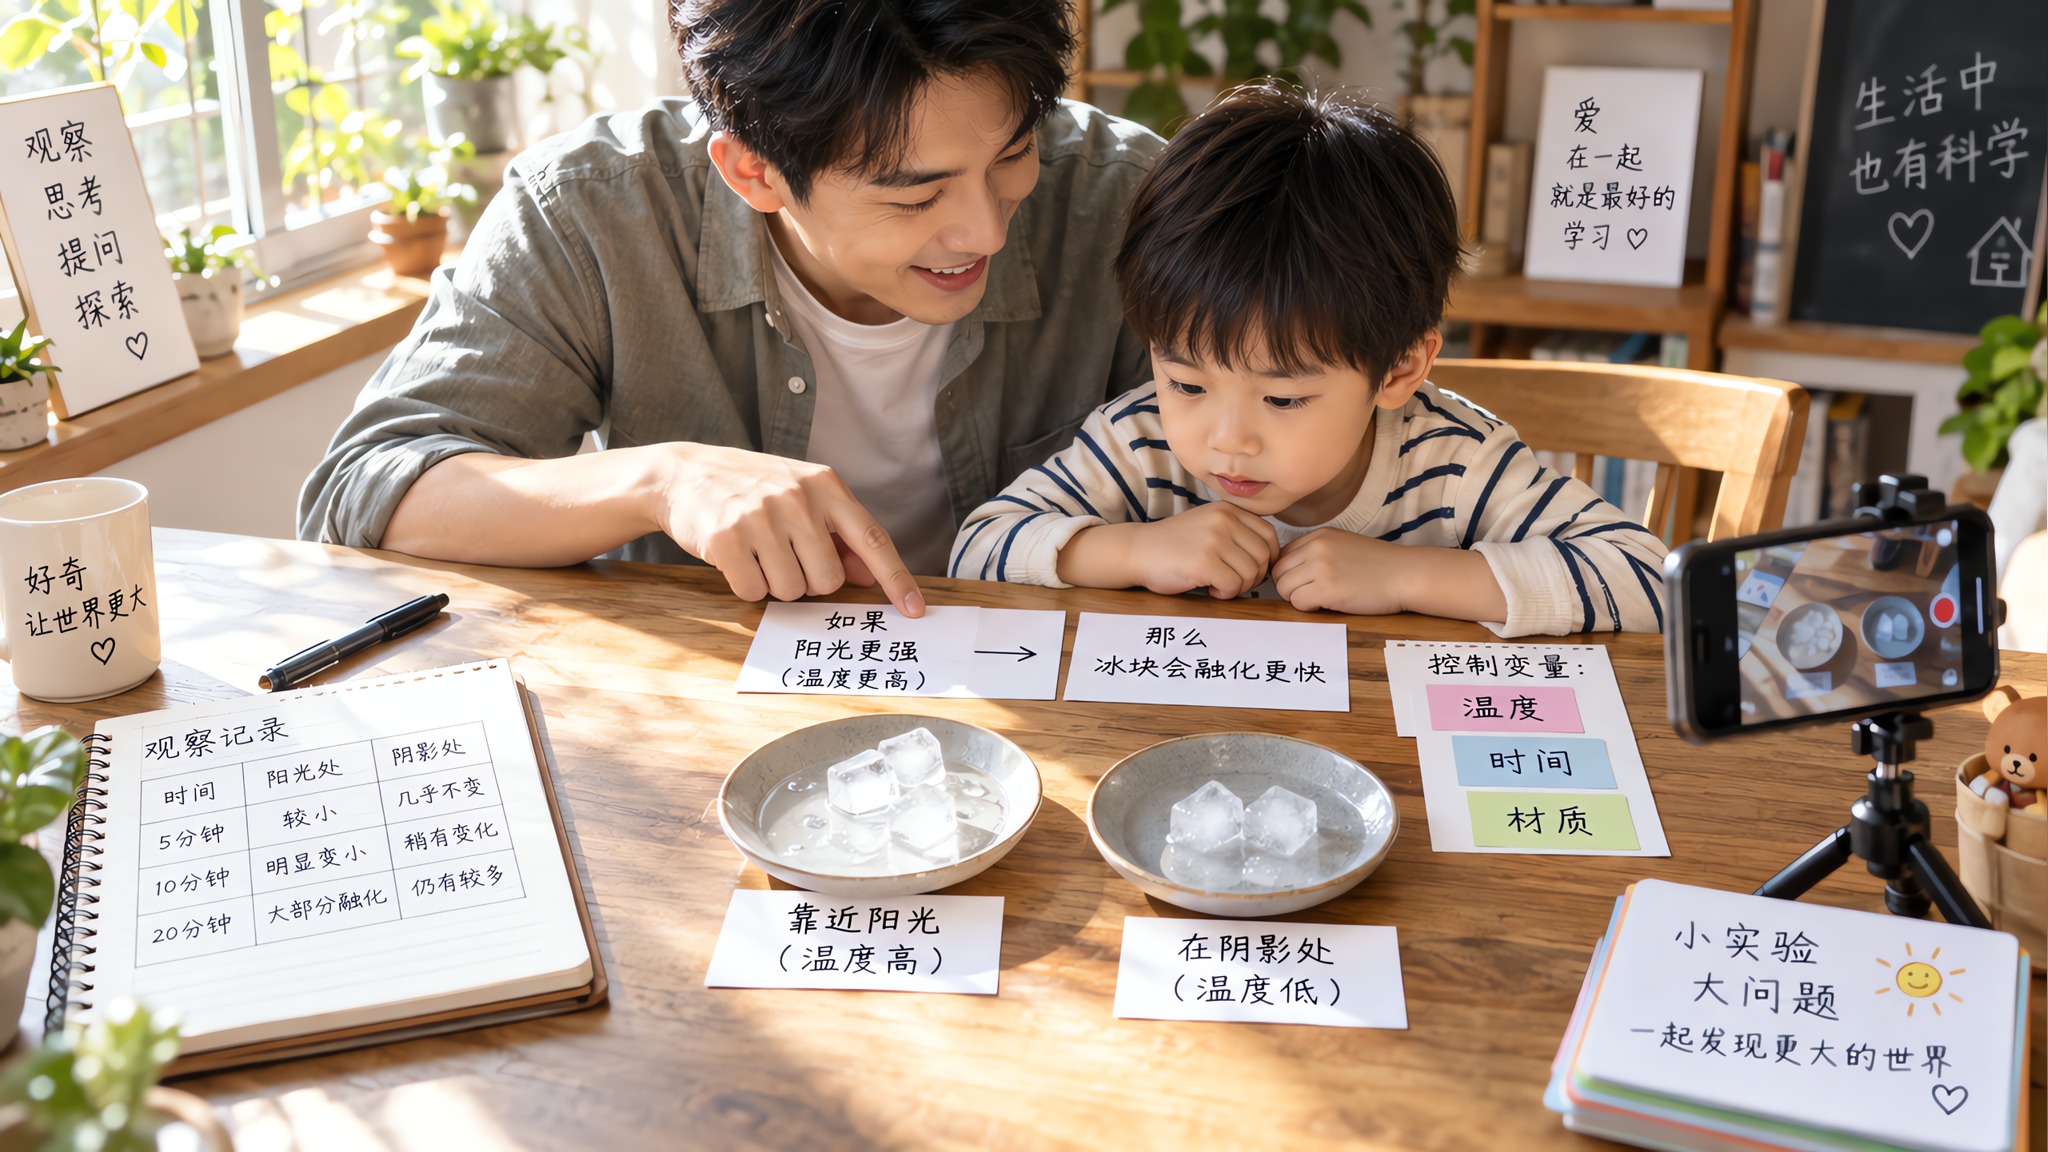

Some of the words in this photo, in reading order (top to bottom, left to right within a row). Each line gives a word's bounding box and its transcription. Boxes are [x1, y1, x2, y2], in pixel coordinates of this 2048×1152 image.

[1854, 52, 1997, 131] 生活中
[1574, 96, 1600, 134] 爱
[25, 120, 92, 163] 观察
[1567, 143, 1642, 171] 在一起
[1849, 118, 2029, 195] 也有科学
[44, 175, 101, 220] 思考
[1550, 182, 1675, 210] 就是最好的
[1564, 221, 1610, 250] 学习
[58, 230, 123, 277] 提问
[75, 280, 138, 329] 探索
[24, 557, 86, 594] 好奇
[25, 584, 146, 636] 让世界更大
[825, 610, 888, 632] 如果
[795, 638, 919, 662] 阳光更强
[1145, 626, 1208, 648] 那么
[781, 668, 927, 691] （温度更高）
[1095, 655, 1326, 684] 冰块会融化更快
[1428, 653, 1584, 679] 控制变量：
[1463, 695, 1544, 721] 温度
[146, 717, 288, 761] 观察记录
[392, 738, 465, 765] 阴影处
[267, 759, 343, 788] 阳光处
[1490, 748, 1572, 776] 时间
[164, 781, 216, 806] 时间
[397, 777, 485, 808] 几乎不变
[282, 804, 337, 830] 较小
[1506, 806, 1592, 835] 材质
[159, 823, 224, 850] 5分钟
[405, 819, 499, 852] 稍有变化
[266, 845, 367, 876] 明显变小
[155, 867, 230, 895] 10分钟
[411, 864, 504, 897] 仍有较多
[268, 888, 388, 924] 大部分融化
[787, 904, 941, 935] 靠近阳光
[152, 913, 231, 943] 20分钟
[1675, 921, 1819, 964] 小实验
[777, 943, 943, 976] （温度高）
[1177, 932, 1334, 965] 在阴影处
[1173, 972, 1341, 1007] （温度低）
[1693, 972, 1839, 1021] 大问题
[1631, 1022, 1951, 1078] 一起发现更大的世界
